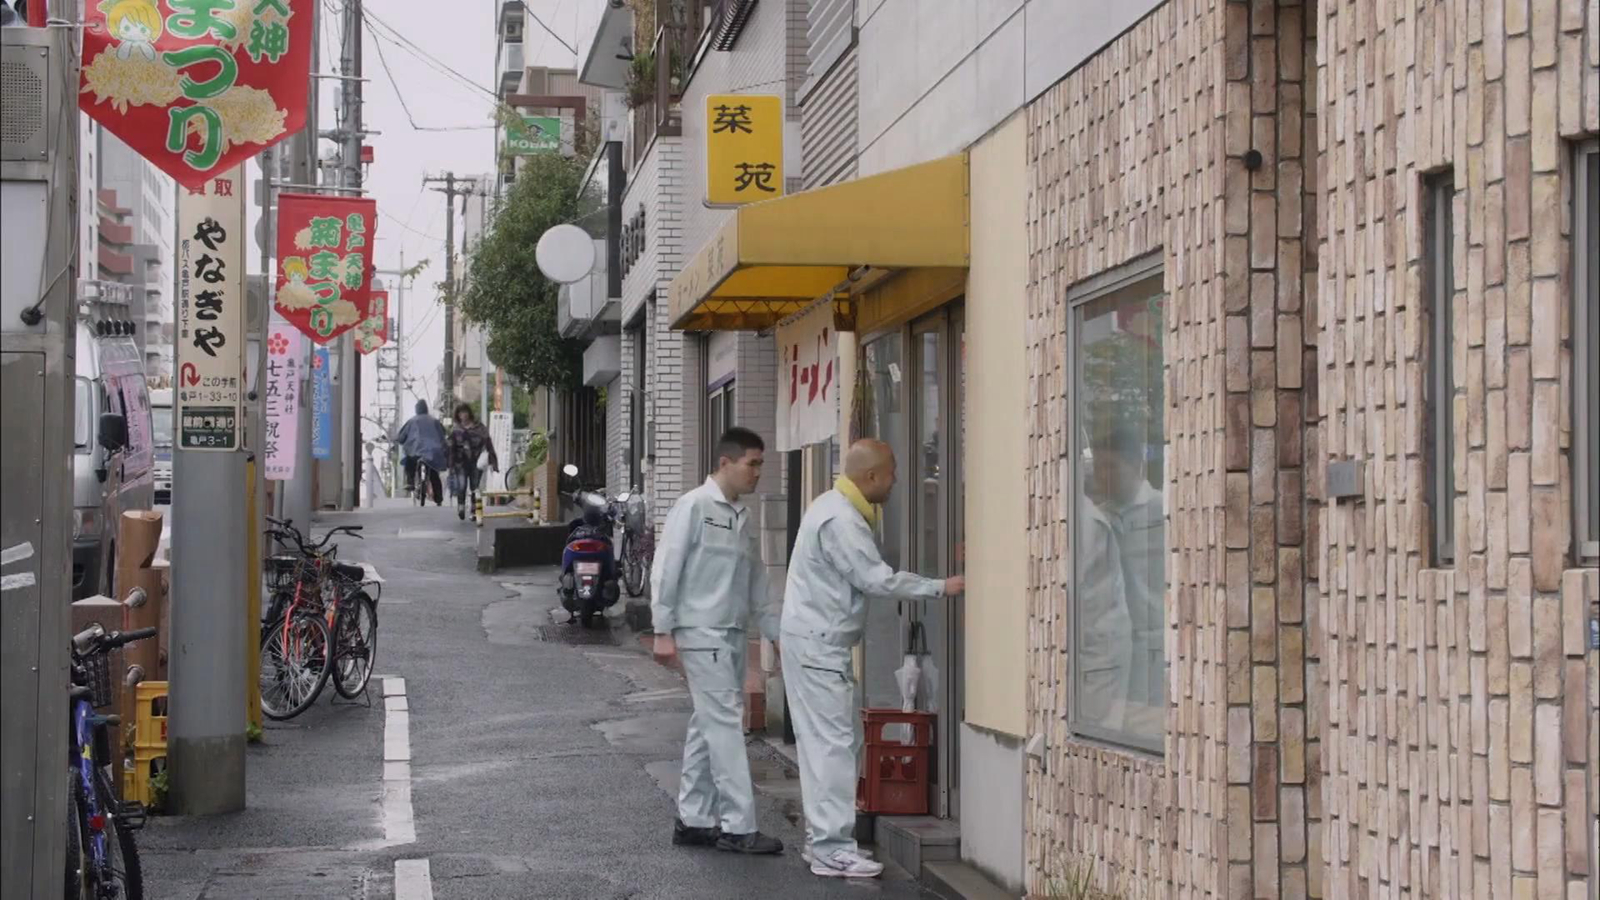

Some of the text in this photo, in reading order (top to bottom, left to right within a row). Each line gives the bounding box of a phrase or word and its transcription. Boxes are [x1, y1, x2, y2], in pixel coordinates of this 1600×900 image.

[713, 105, 776, 192] 菜苑
[194, 217, 226, 357] やなぎや
[309, 216, 344, 336] 菊まつり
[345, 213, 365, 290] 亀戸天神
[202, 376, 237, 389] この手前
[265, 359, 283, 459] 七五三祝祭
[284, 358, 297, 415] 亀戸天神社
